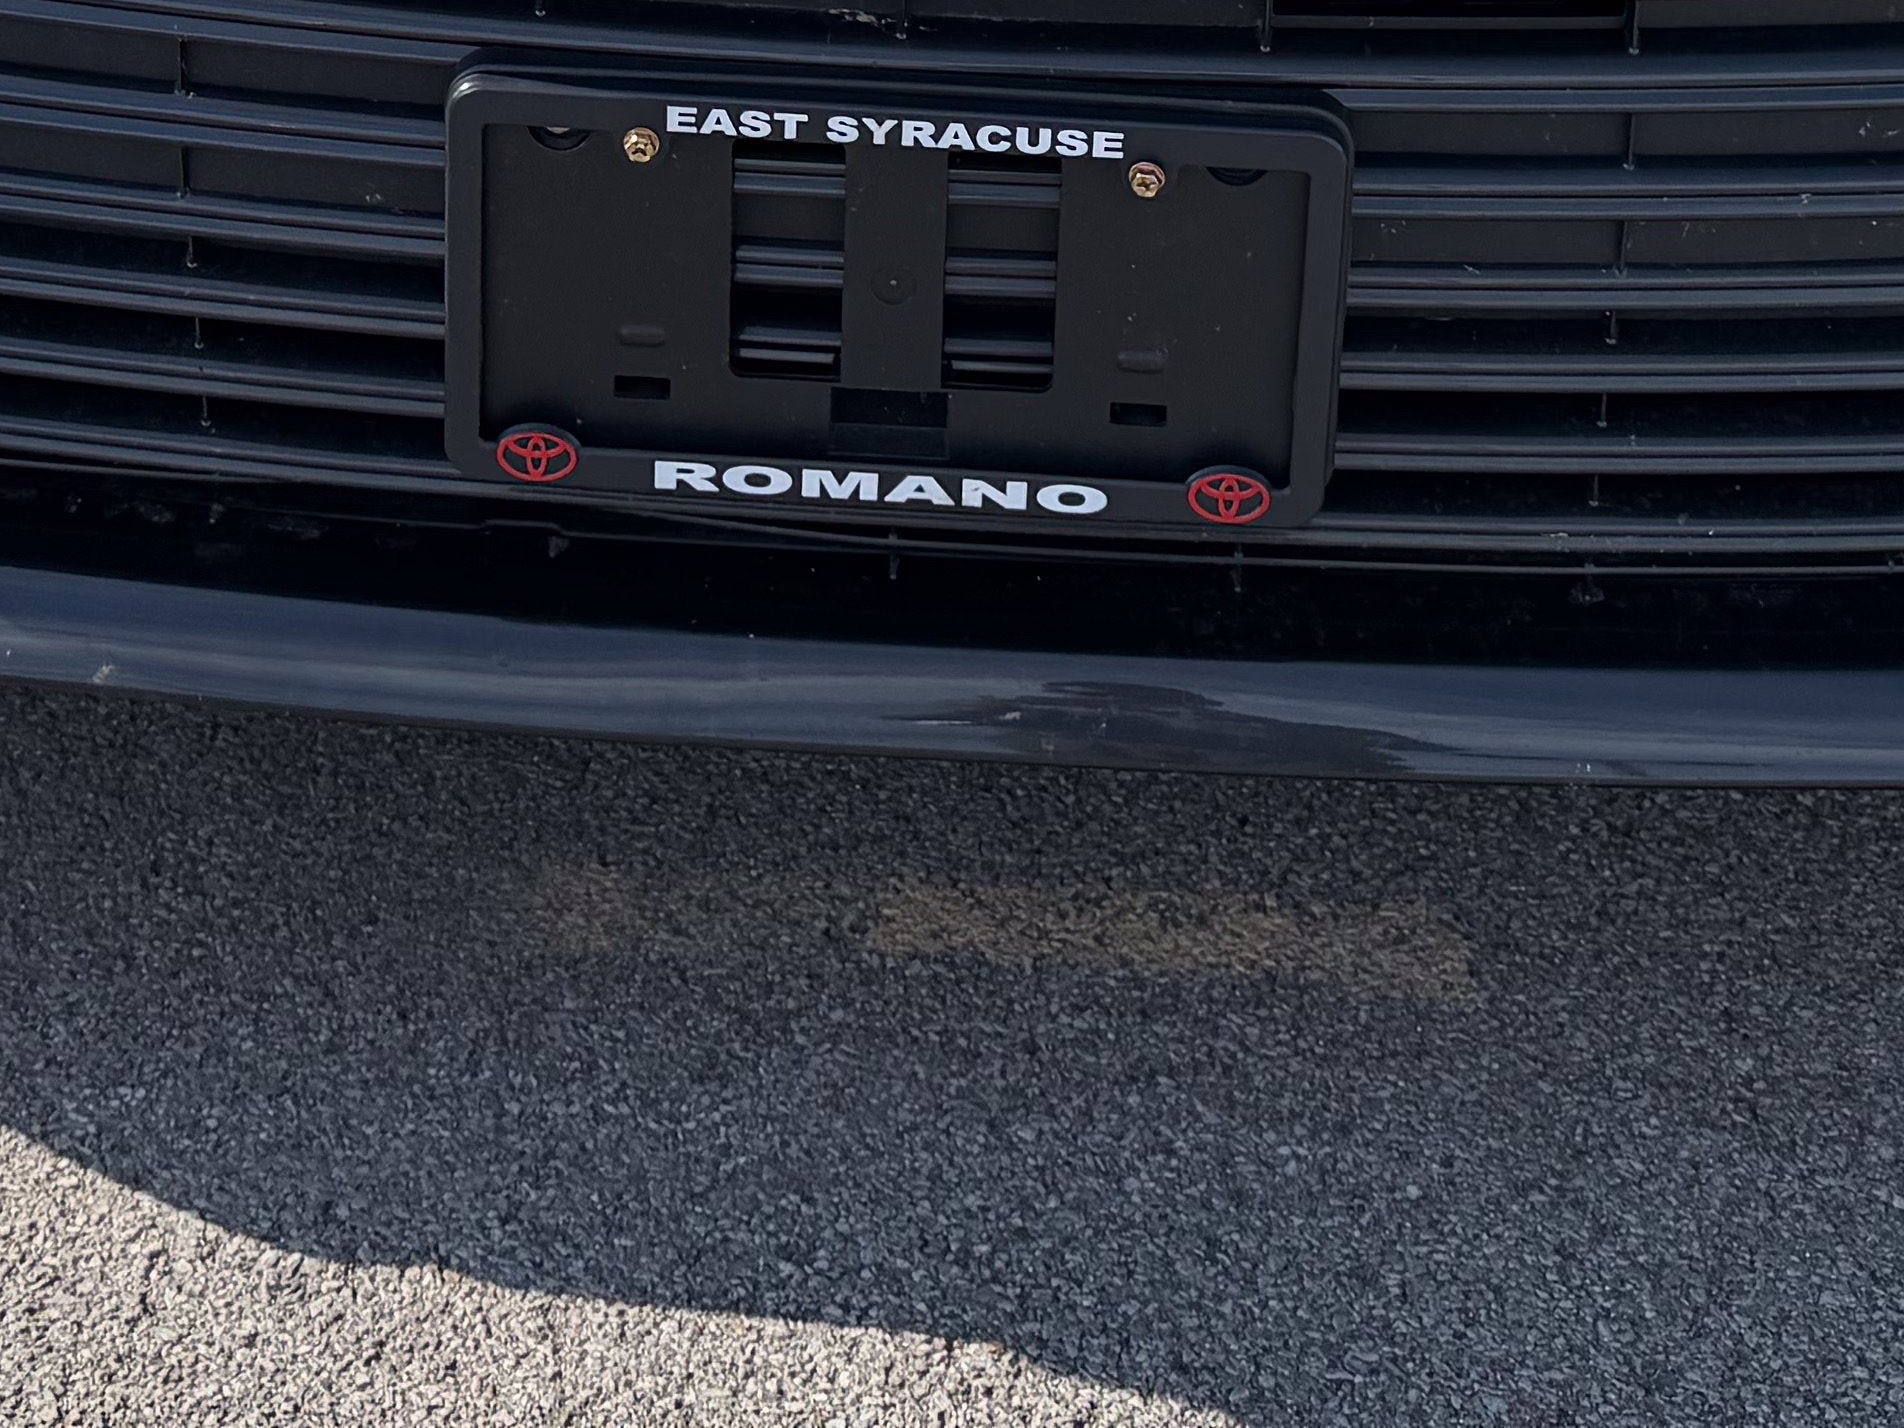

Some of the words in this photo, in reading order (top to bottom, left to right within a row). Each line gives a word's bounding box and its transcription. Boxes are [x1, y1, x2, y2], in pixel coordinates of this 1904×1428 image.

[666, 105, 808, 139] EAST
[826, 116, 1125, 159] SYRACUSE
[654, 460, 1109, 515] ROMANO
